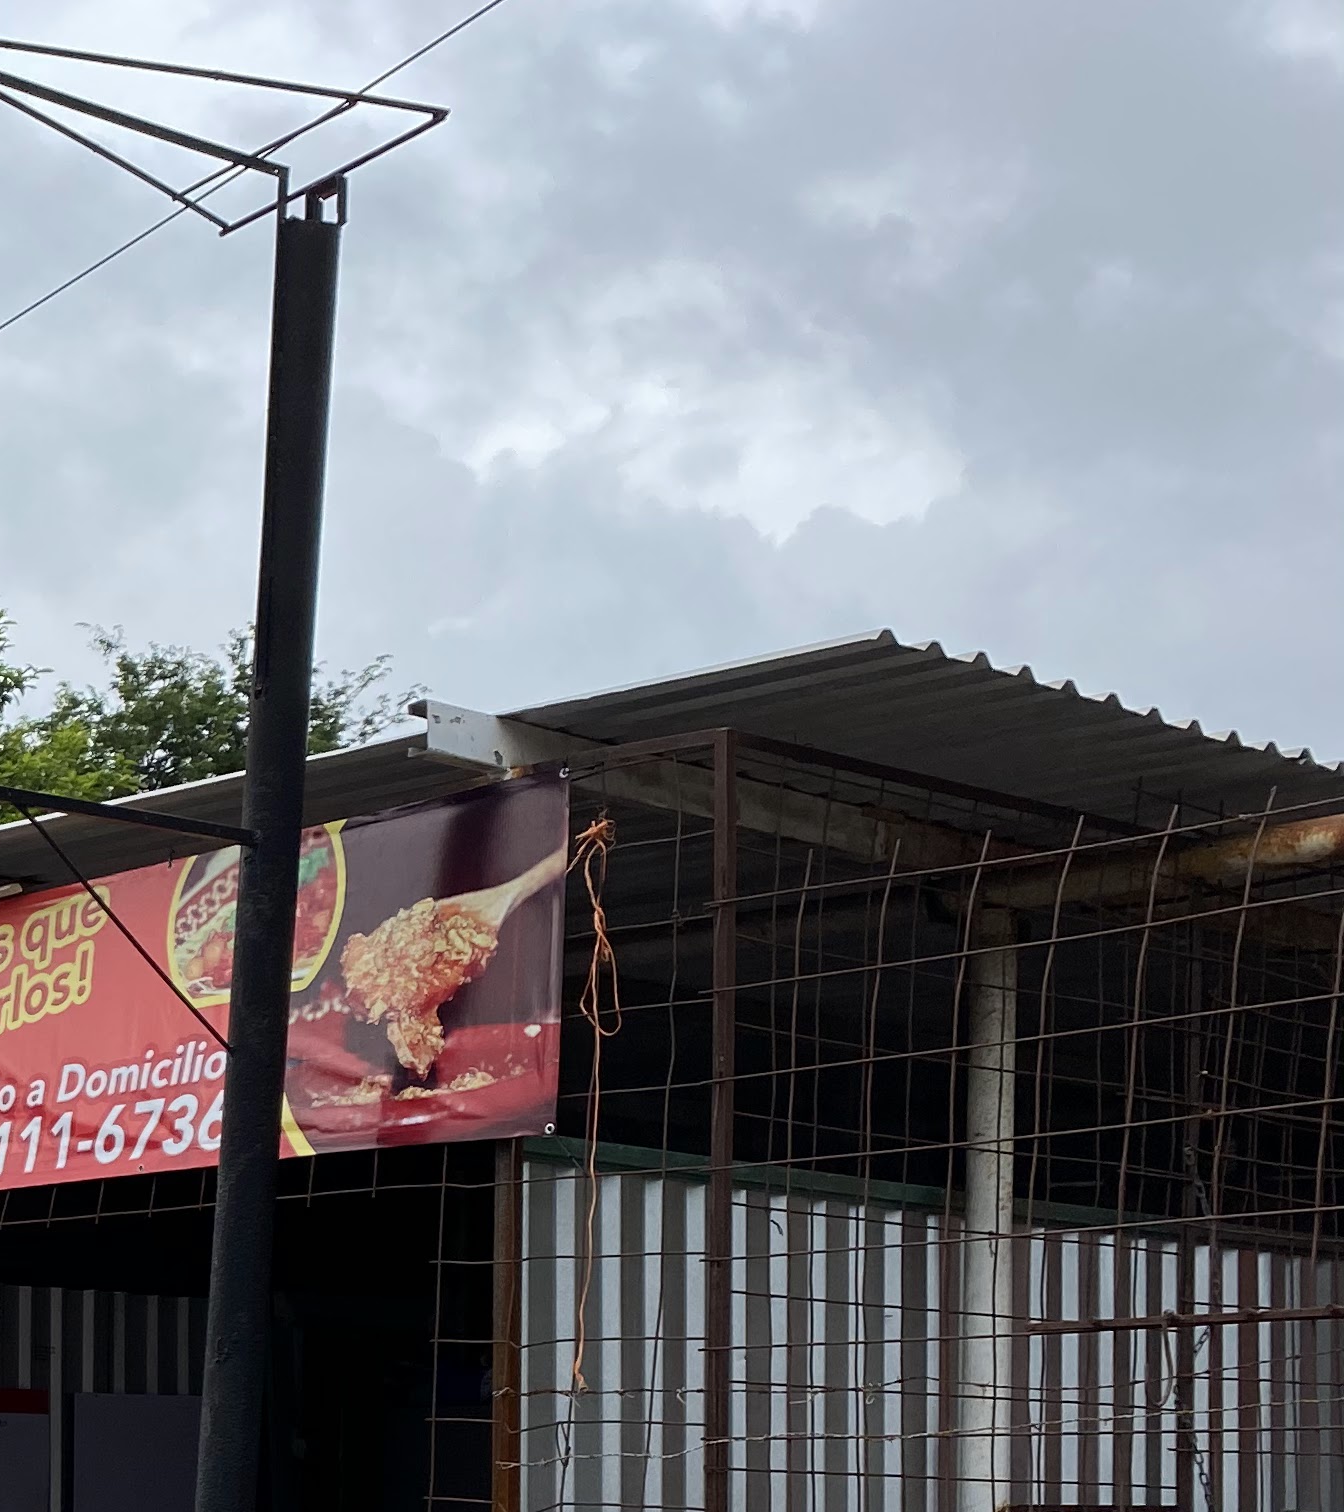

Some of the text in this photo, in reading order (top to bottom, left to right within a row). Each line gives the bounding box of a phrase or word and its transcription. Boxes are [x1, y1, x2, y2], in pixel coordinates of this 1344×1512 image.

[23, 889, 107, 966] que
[26, 1079, 46, 1107] a
[56, 1040, 227, 1103] Domicilio
